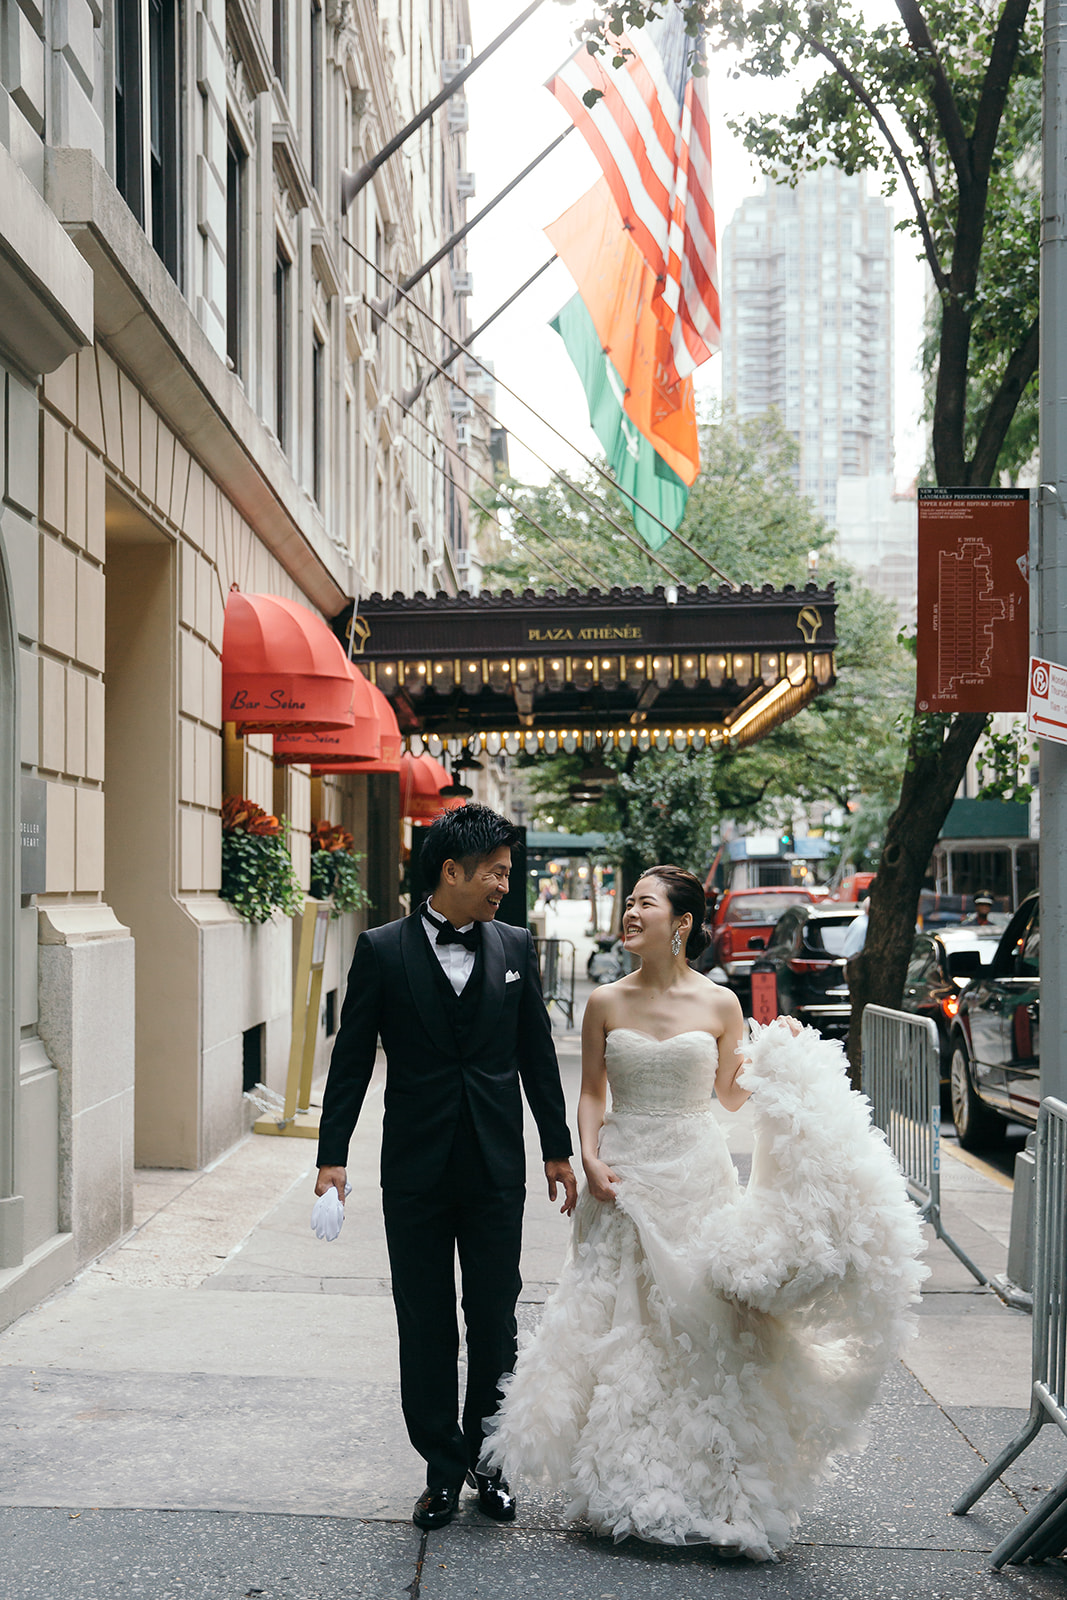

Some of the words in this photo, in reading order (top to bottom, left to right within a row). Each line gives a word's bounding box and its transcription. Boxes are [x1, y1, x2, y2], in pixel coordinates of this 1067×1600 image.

[528, 628, 574, 641] PLAZA
[577, 623, 642, 640] ATHÉNÉE
[230, 690, 260, 709] Bar
[264, 690, 305, 709] Seine
[933, 1108, 941, 1171] NYPD
